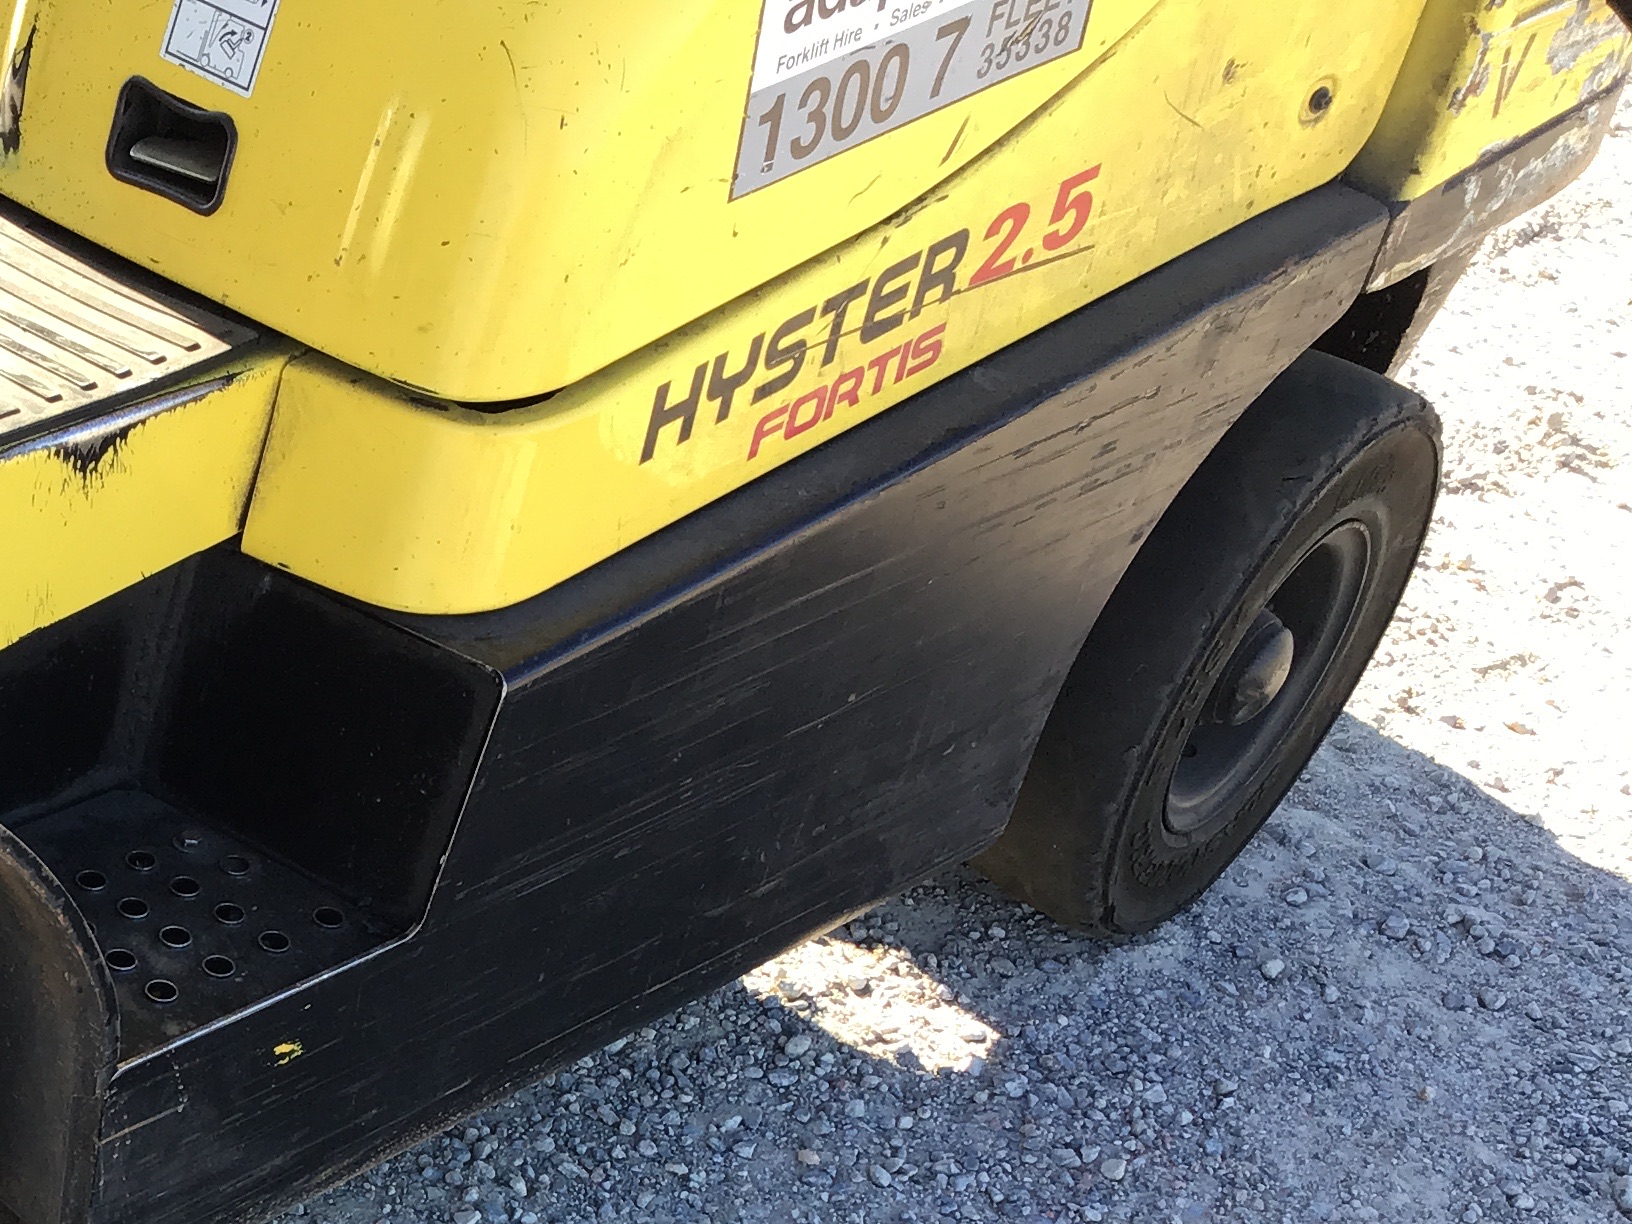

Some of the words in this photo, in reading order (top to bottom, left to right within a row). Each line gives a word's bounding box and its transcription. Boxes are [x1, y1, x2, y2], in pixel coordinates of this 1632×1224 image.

[776, 38, 829, 74] Forklift
[833, 28, 863, 50] Hire
[890, 1, 932, 26] Sales
[986, 0, 1072, 38] FLE
[758, 43, 910, 174] 1300
[929, 14, 973, 99] 7
[639, 227, 970, 466] HYSTER
[968, 163, 1103, 286] 2.5
[747, 323, 946, 461] FORTIS
